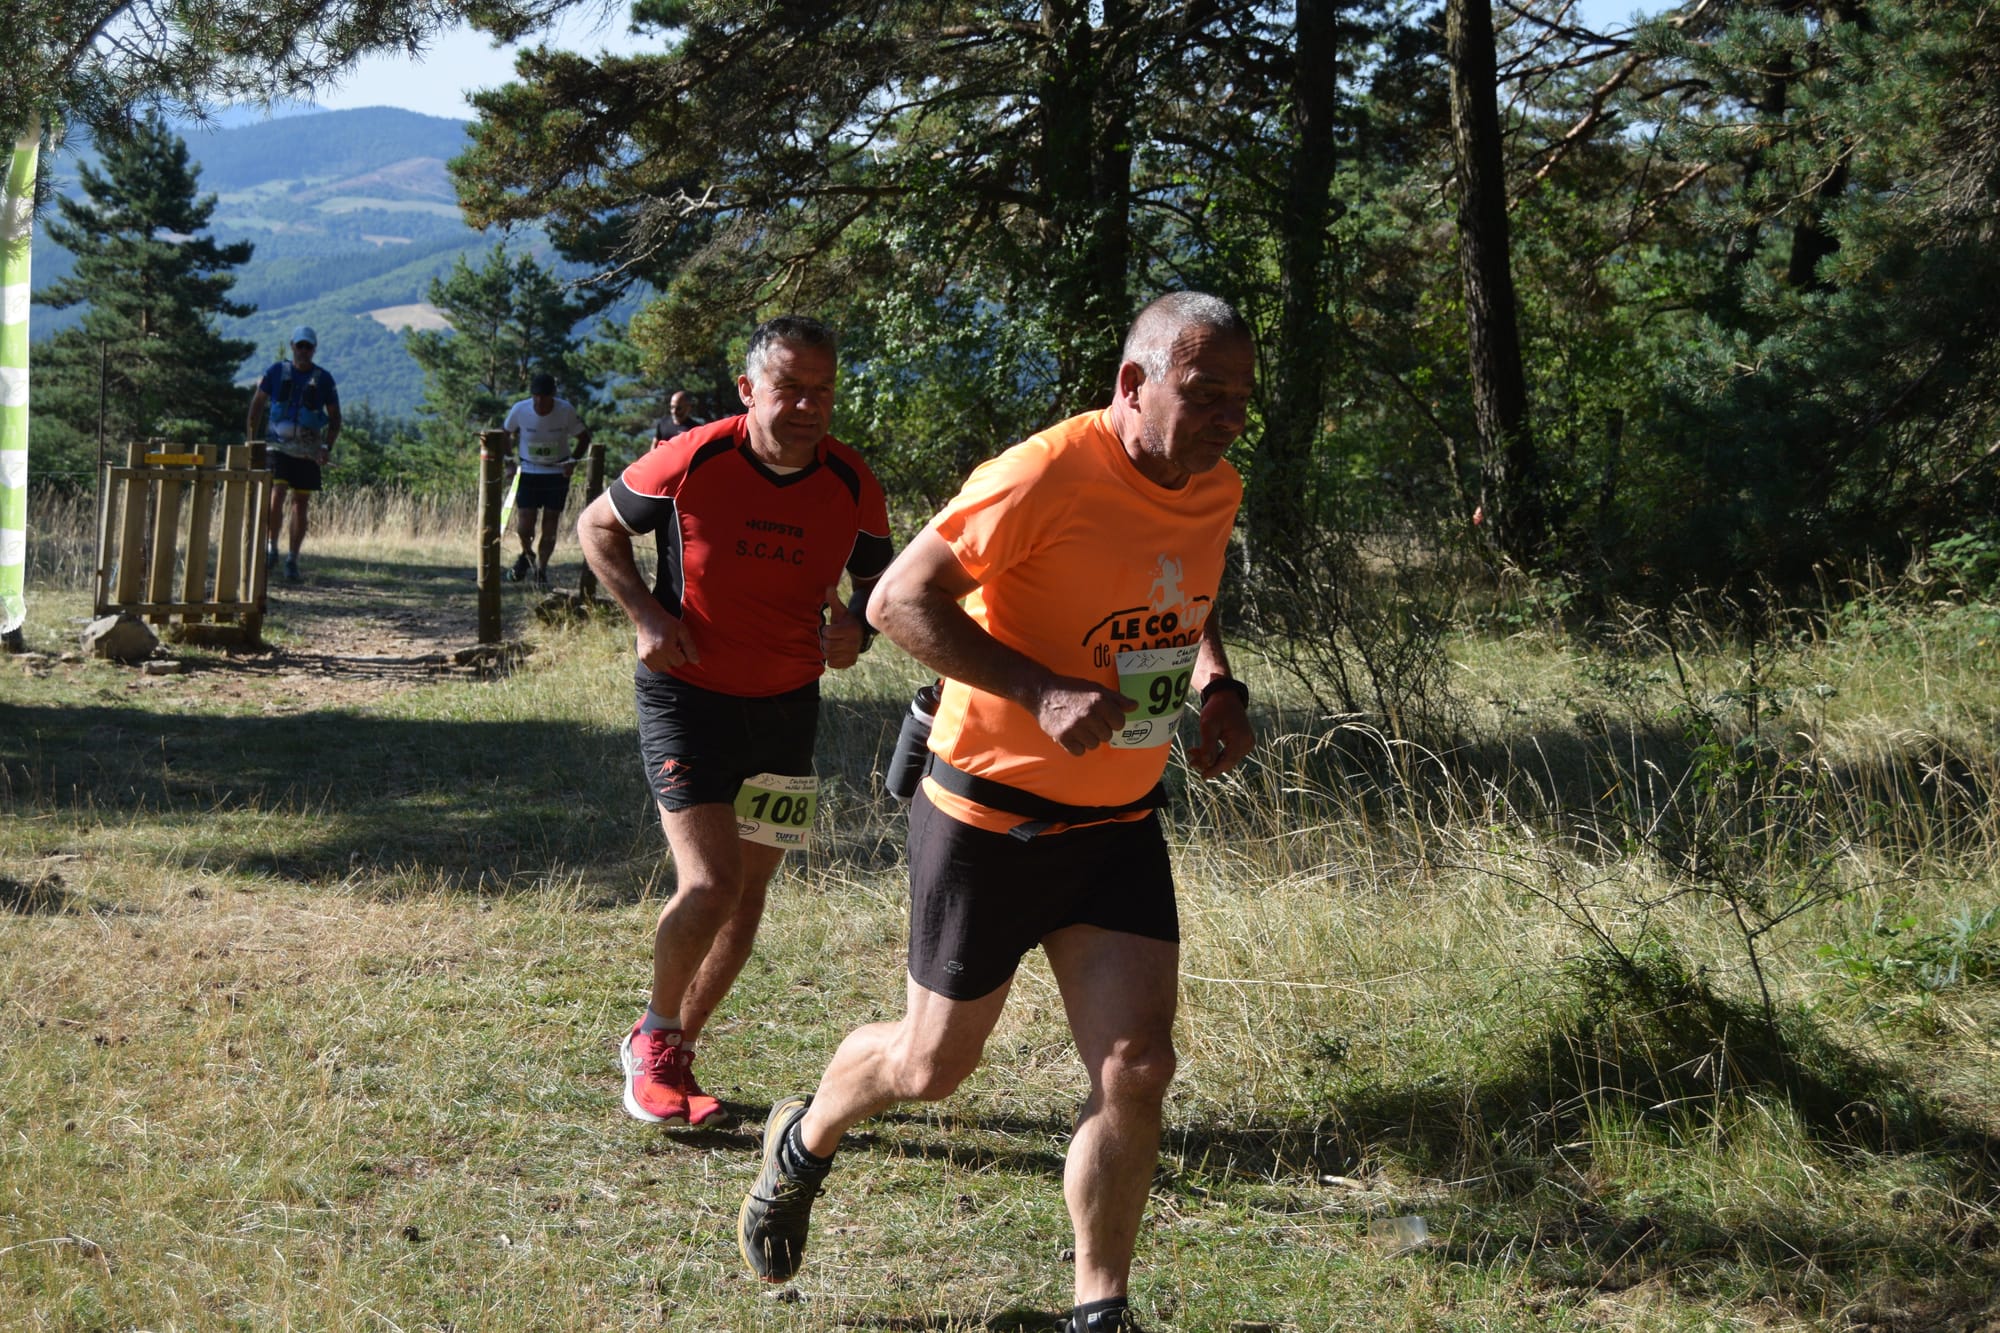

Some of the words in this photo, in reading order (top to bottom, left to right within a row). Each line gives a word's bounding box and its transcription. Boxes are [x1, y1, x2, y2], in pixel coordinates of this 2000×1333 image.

[1110, 618, 1140, 640] LE
[1145, 604, 1209, 636] COUP
[1094, 642, 1111, 668] de
[1148, 671, 1191, 715] 99
[1122, 728, 1148, 738] BFP
[752, 792, 808, 826] 108
